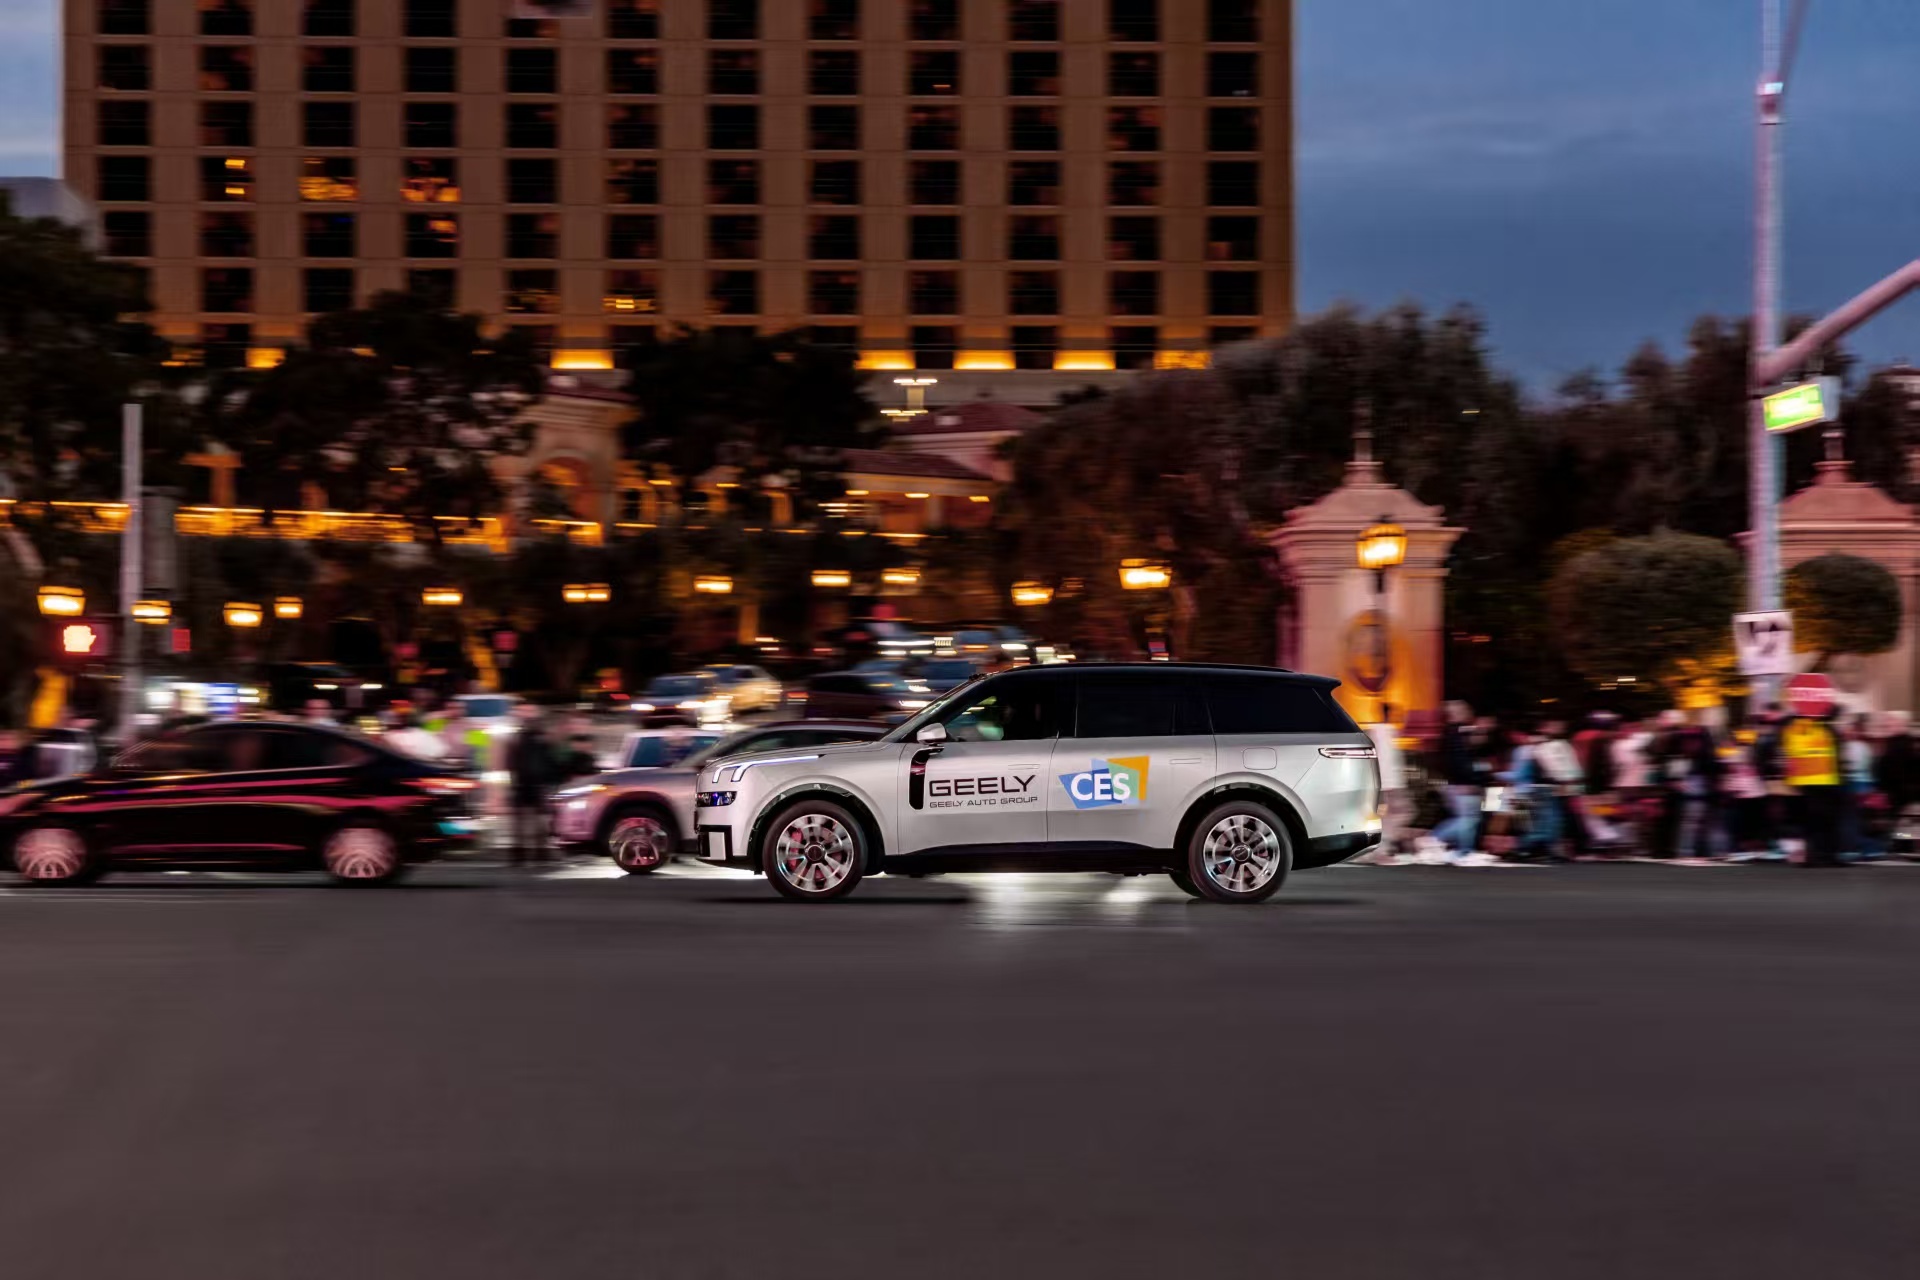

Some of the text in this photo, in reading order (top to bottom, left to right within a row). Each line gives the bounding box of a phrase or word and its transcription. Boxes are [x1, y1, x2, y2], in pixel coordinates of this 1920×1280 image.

[929, 774, 1036, 797] GEELY
[1070, 773, 1131, 801] CES
[929, 796, 1038, 808] GEELY AUTO GROUP
